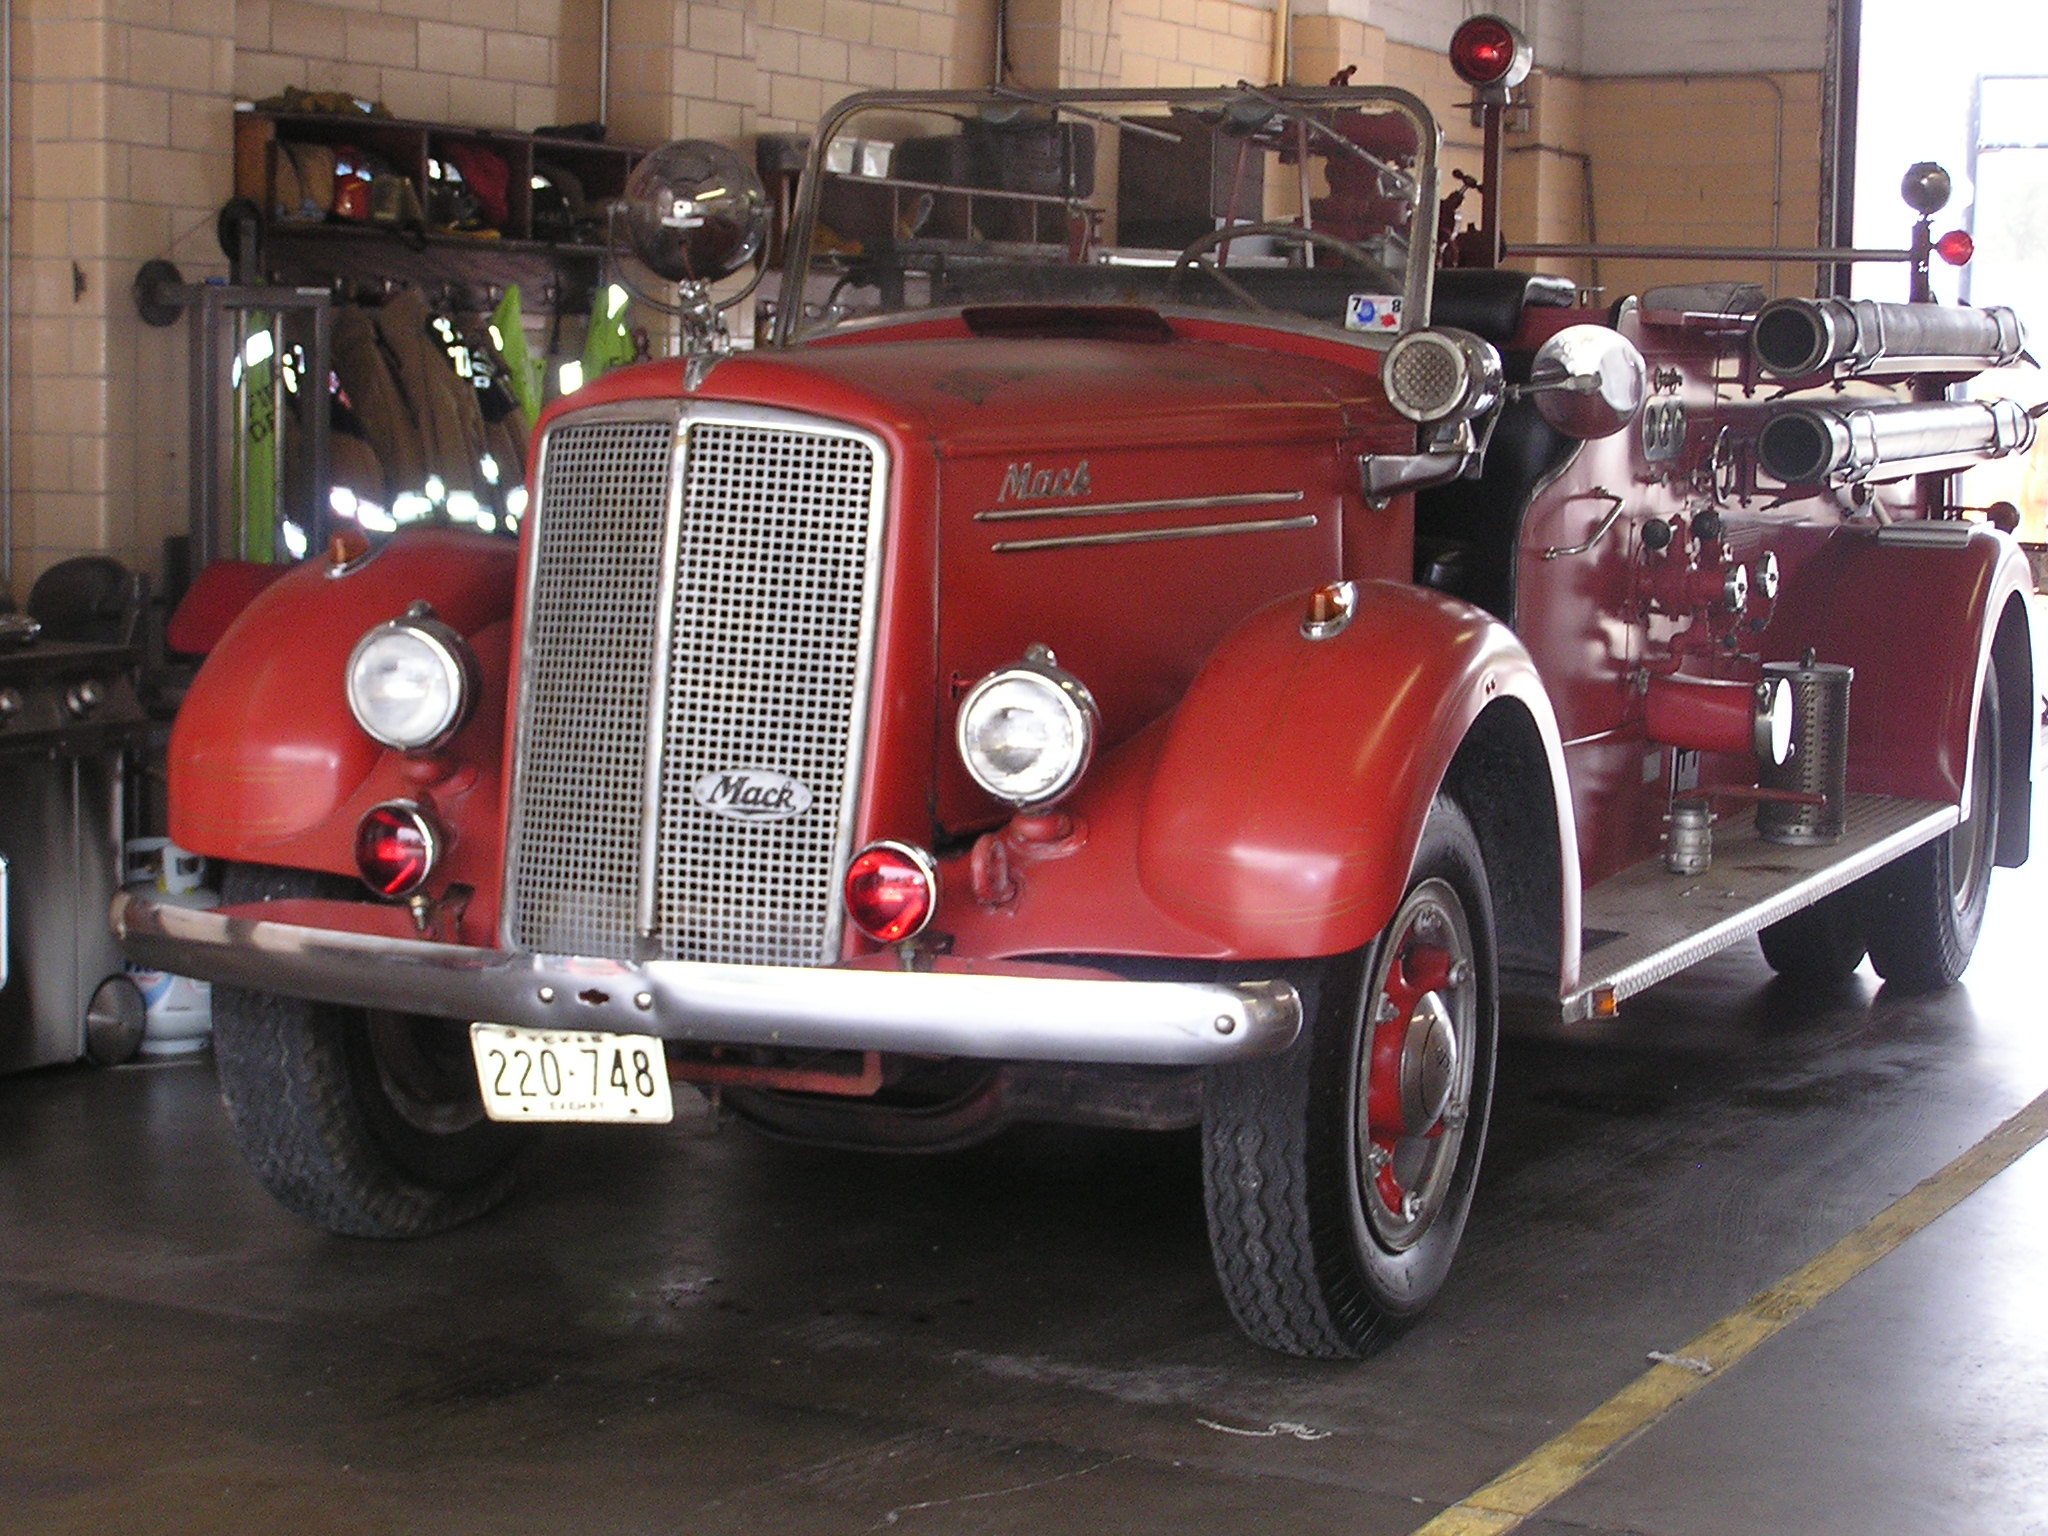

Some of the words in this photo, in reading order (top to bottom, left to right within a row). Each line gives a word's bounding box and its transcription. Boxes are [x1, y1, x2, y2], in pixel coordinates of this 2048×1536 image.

[1352, 297, 1361, 311] 7
[1391, 299, 1401, 313] 8
[997, 459, 1092, 503] Mack
[706, 774, 797, 813] Mack
